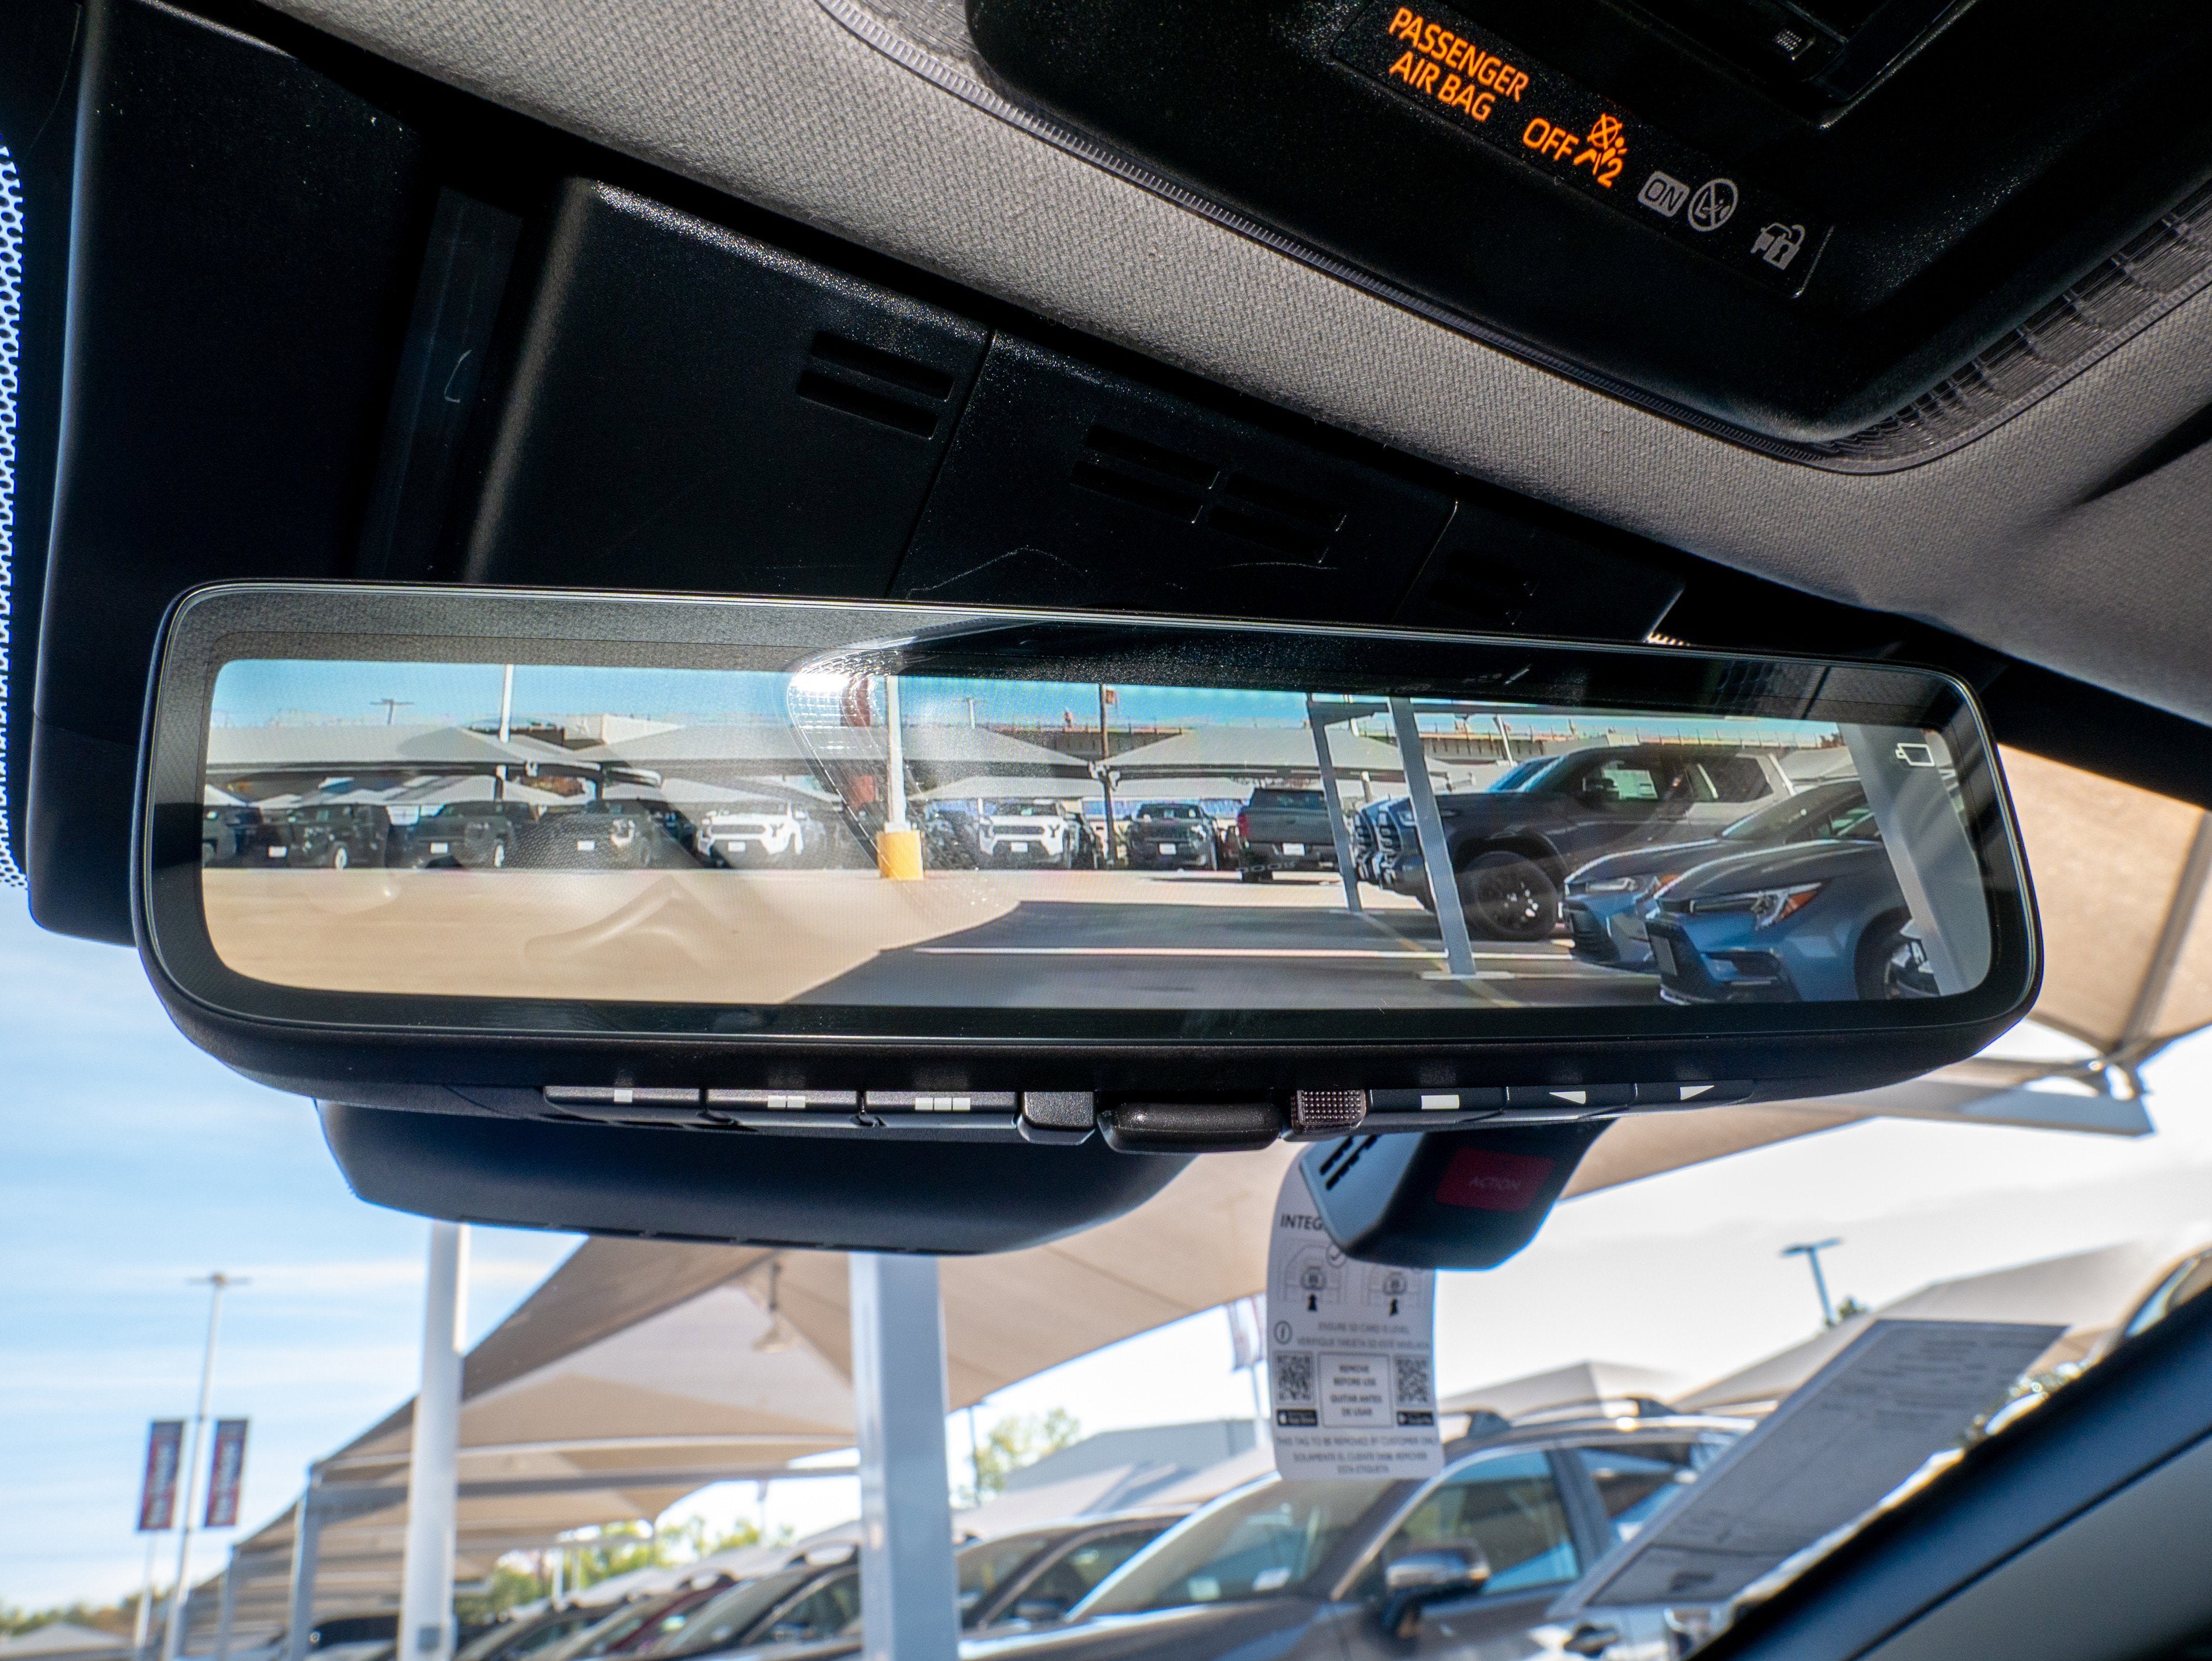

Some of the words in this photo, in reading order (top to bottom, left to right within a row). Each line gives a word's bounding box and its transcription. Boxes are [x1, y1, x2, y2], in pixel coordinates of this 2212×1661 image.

[1388, 7, 1530, 103] PASSENGER
[1389, 51, 1439, 95] AIR
[1438, 71, 1497, 122] BAG
[1522, 117, 1580, 161] OFF
[1645, 177, 1684, 212] ON
[1280, 1213, 1324, 1231] INTEG
